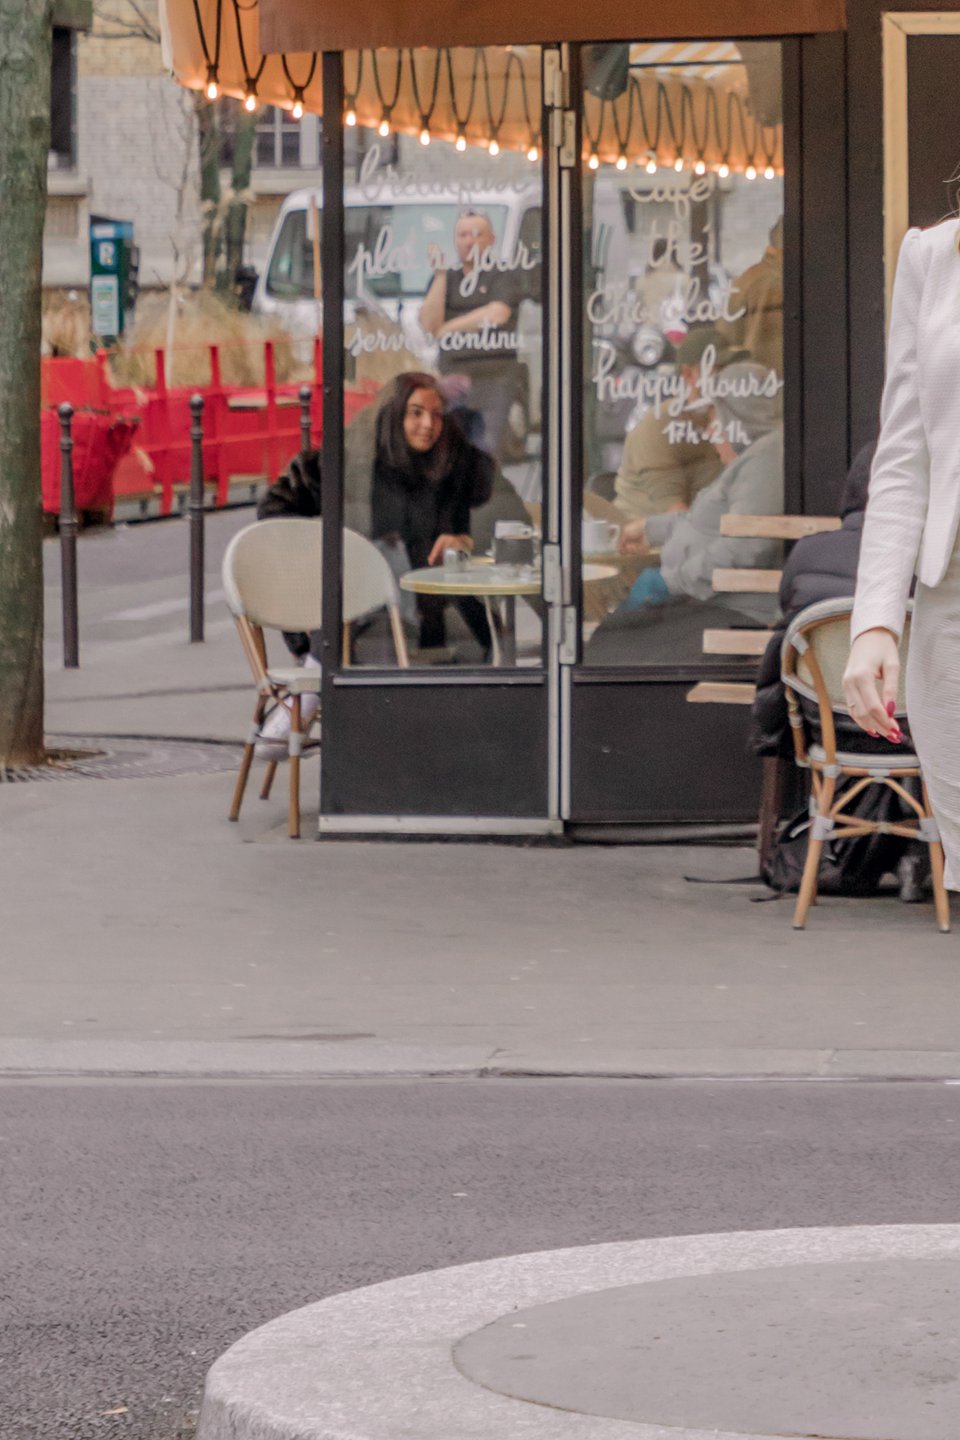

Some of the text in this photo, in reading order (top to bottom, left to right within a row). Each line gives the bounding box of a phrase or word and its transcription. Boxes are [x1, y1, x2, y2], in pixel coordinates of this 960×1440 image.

[459, 228, 536, 298] jour
[345, 327, 438, 357] serve
[592, 340, 785, 419] happy hours
